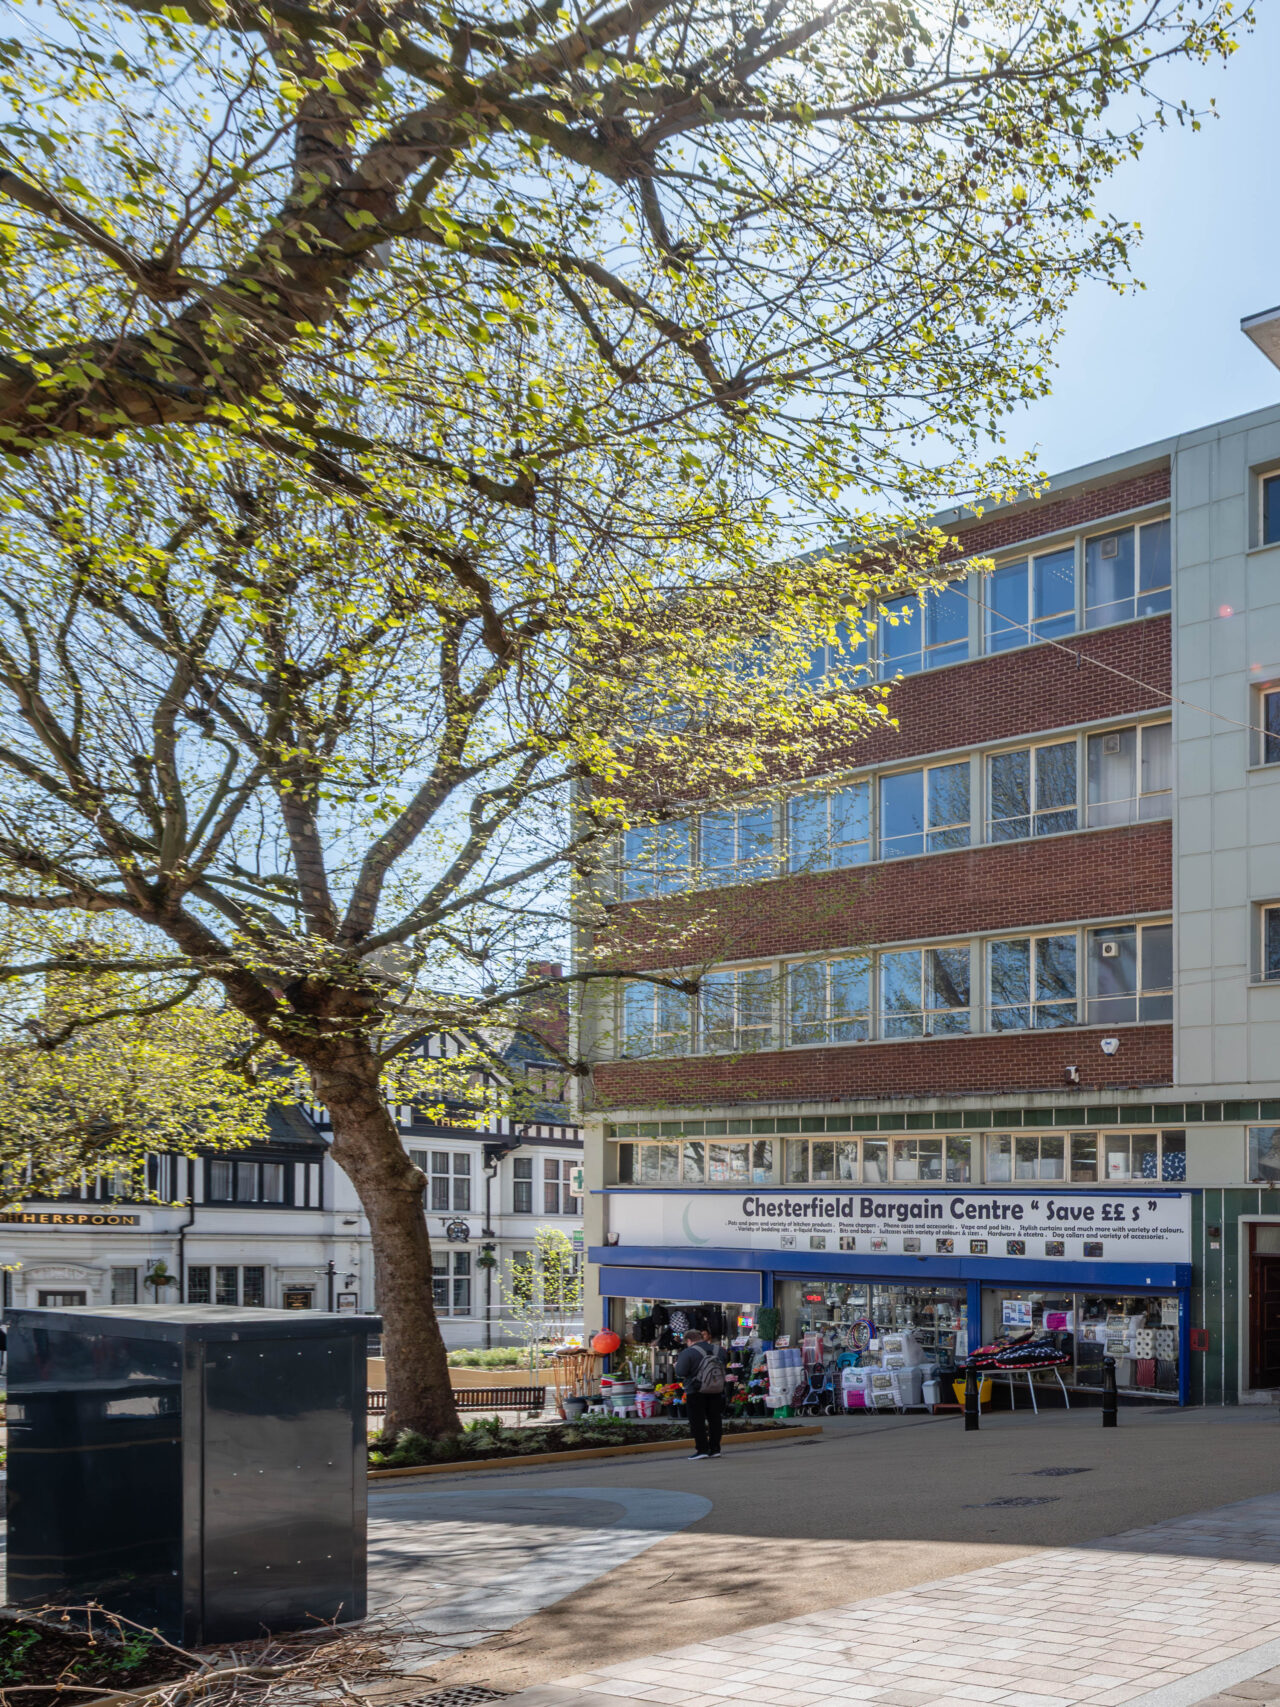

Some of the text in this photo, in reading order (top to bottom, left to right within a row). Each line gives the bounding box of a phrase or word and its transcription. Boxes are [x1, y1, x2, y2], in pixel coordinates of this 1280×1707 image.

[742, 1196, 853, 1218] Chesterfield
[860, 1197, 943, 1221] Bargain
[950, 1197, 1023, 1220] Centre
[1046, 1200, 1095, 1221] Save
